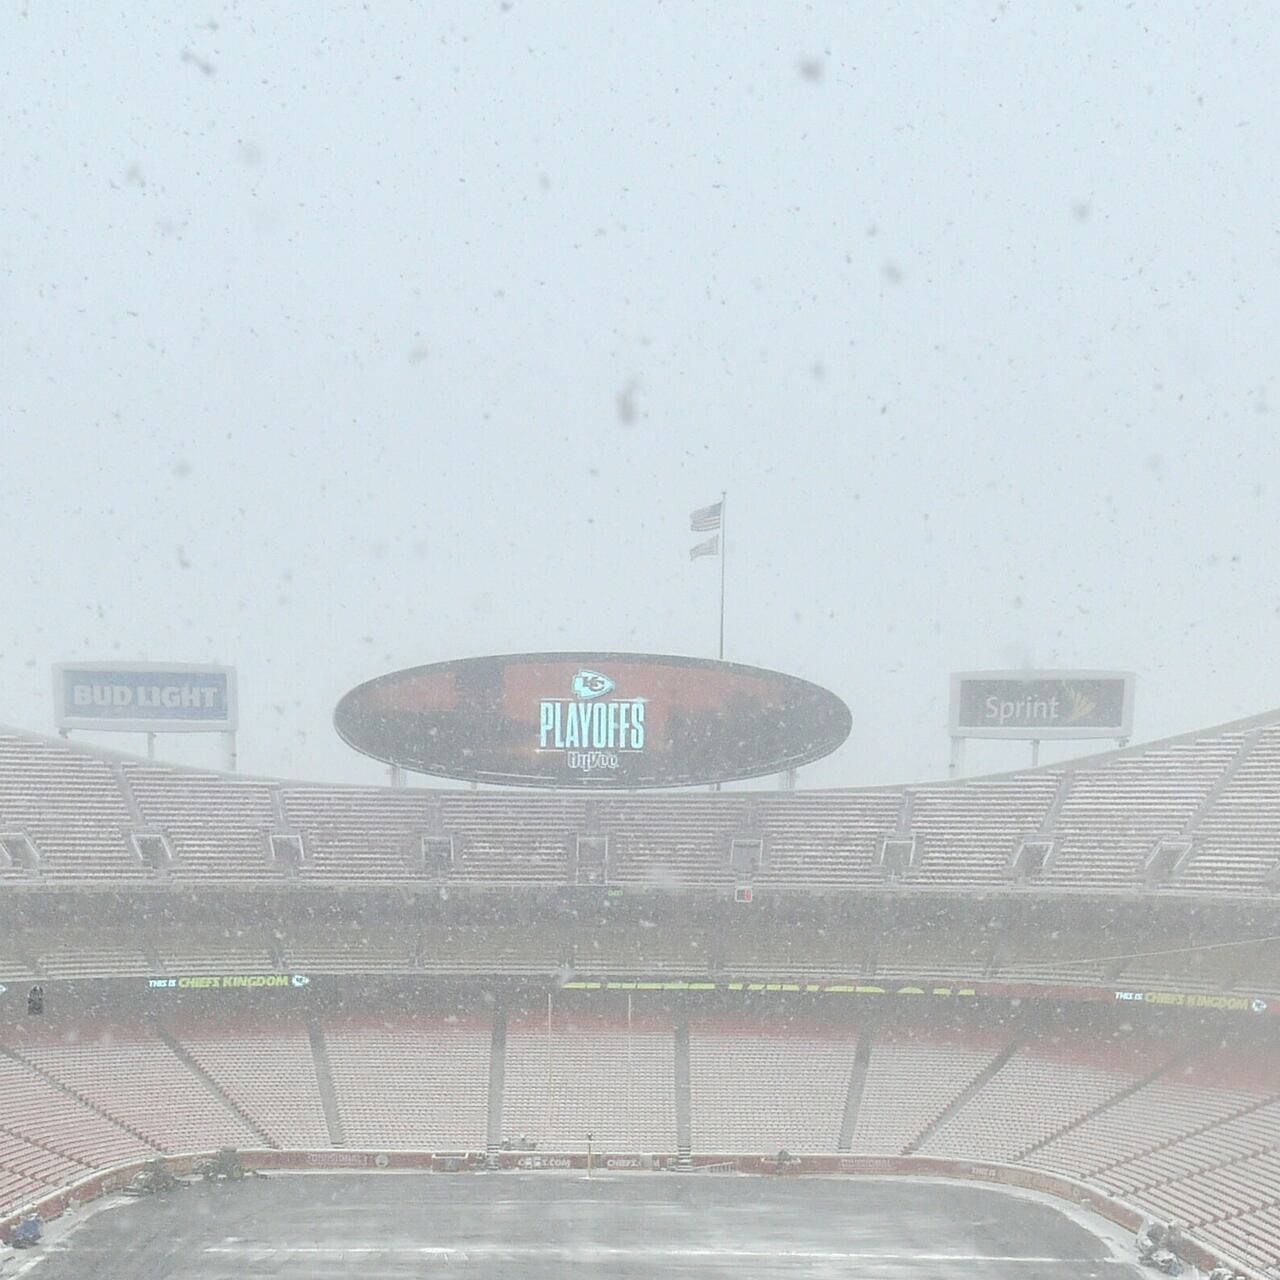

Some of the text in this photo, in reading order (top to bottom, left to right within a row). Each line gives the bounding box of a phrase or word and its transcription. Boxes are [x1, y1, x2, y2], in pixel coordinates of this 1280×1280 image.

[73, 685, 218, 708] BUD LIGHT
[985, 694, 1059, 724] Sprint
[540, 702, 644, 748] PLAYOFFS
[178, 976, 221, 988] CHIEFS
[223, 975, 289, 987] KINGDOM
[1145, 992, 1185, 1005] CHIEFS
[1187, 994, 1249, 1010] KINGDOM
